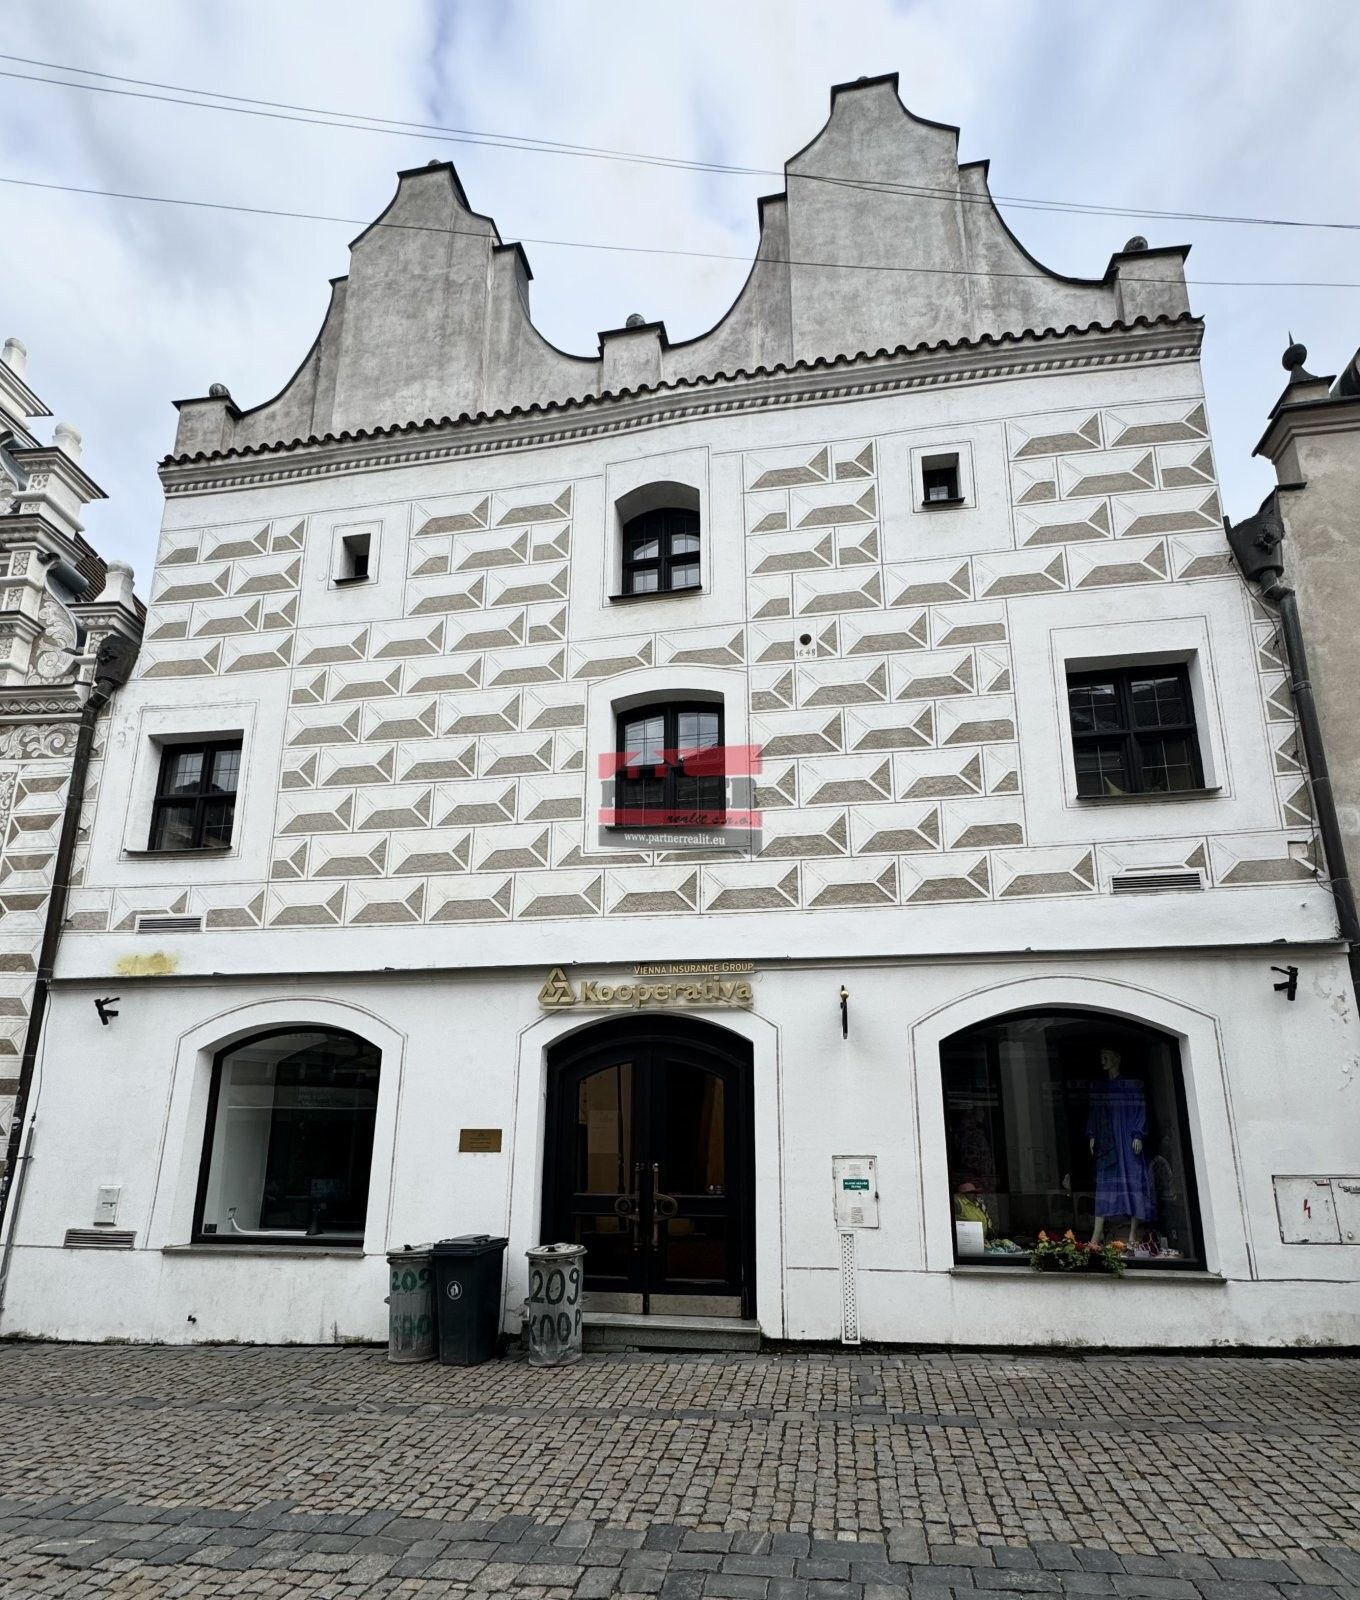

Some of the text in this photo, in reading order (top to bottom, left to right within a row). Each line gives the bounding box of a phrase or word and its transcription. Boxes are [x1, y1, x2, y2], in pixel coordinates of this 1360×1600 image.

[633, 962, 754, 975] VIENNA INSURANCE GROUP
[579, 976, 754, 1008] Kooperativa
[530, 1267, 581, 1306] 209
